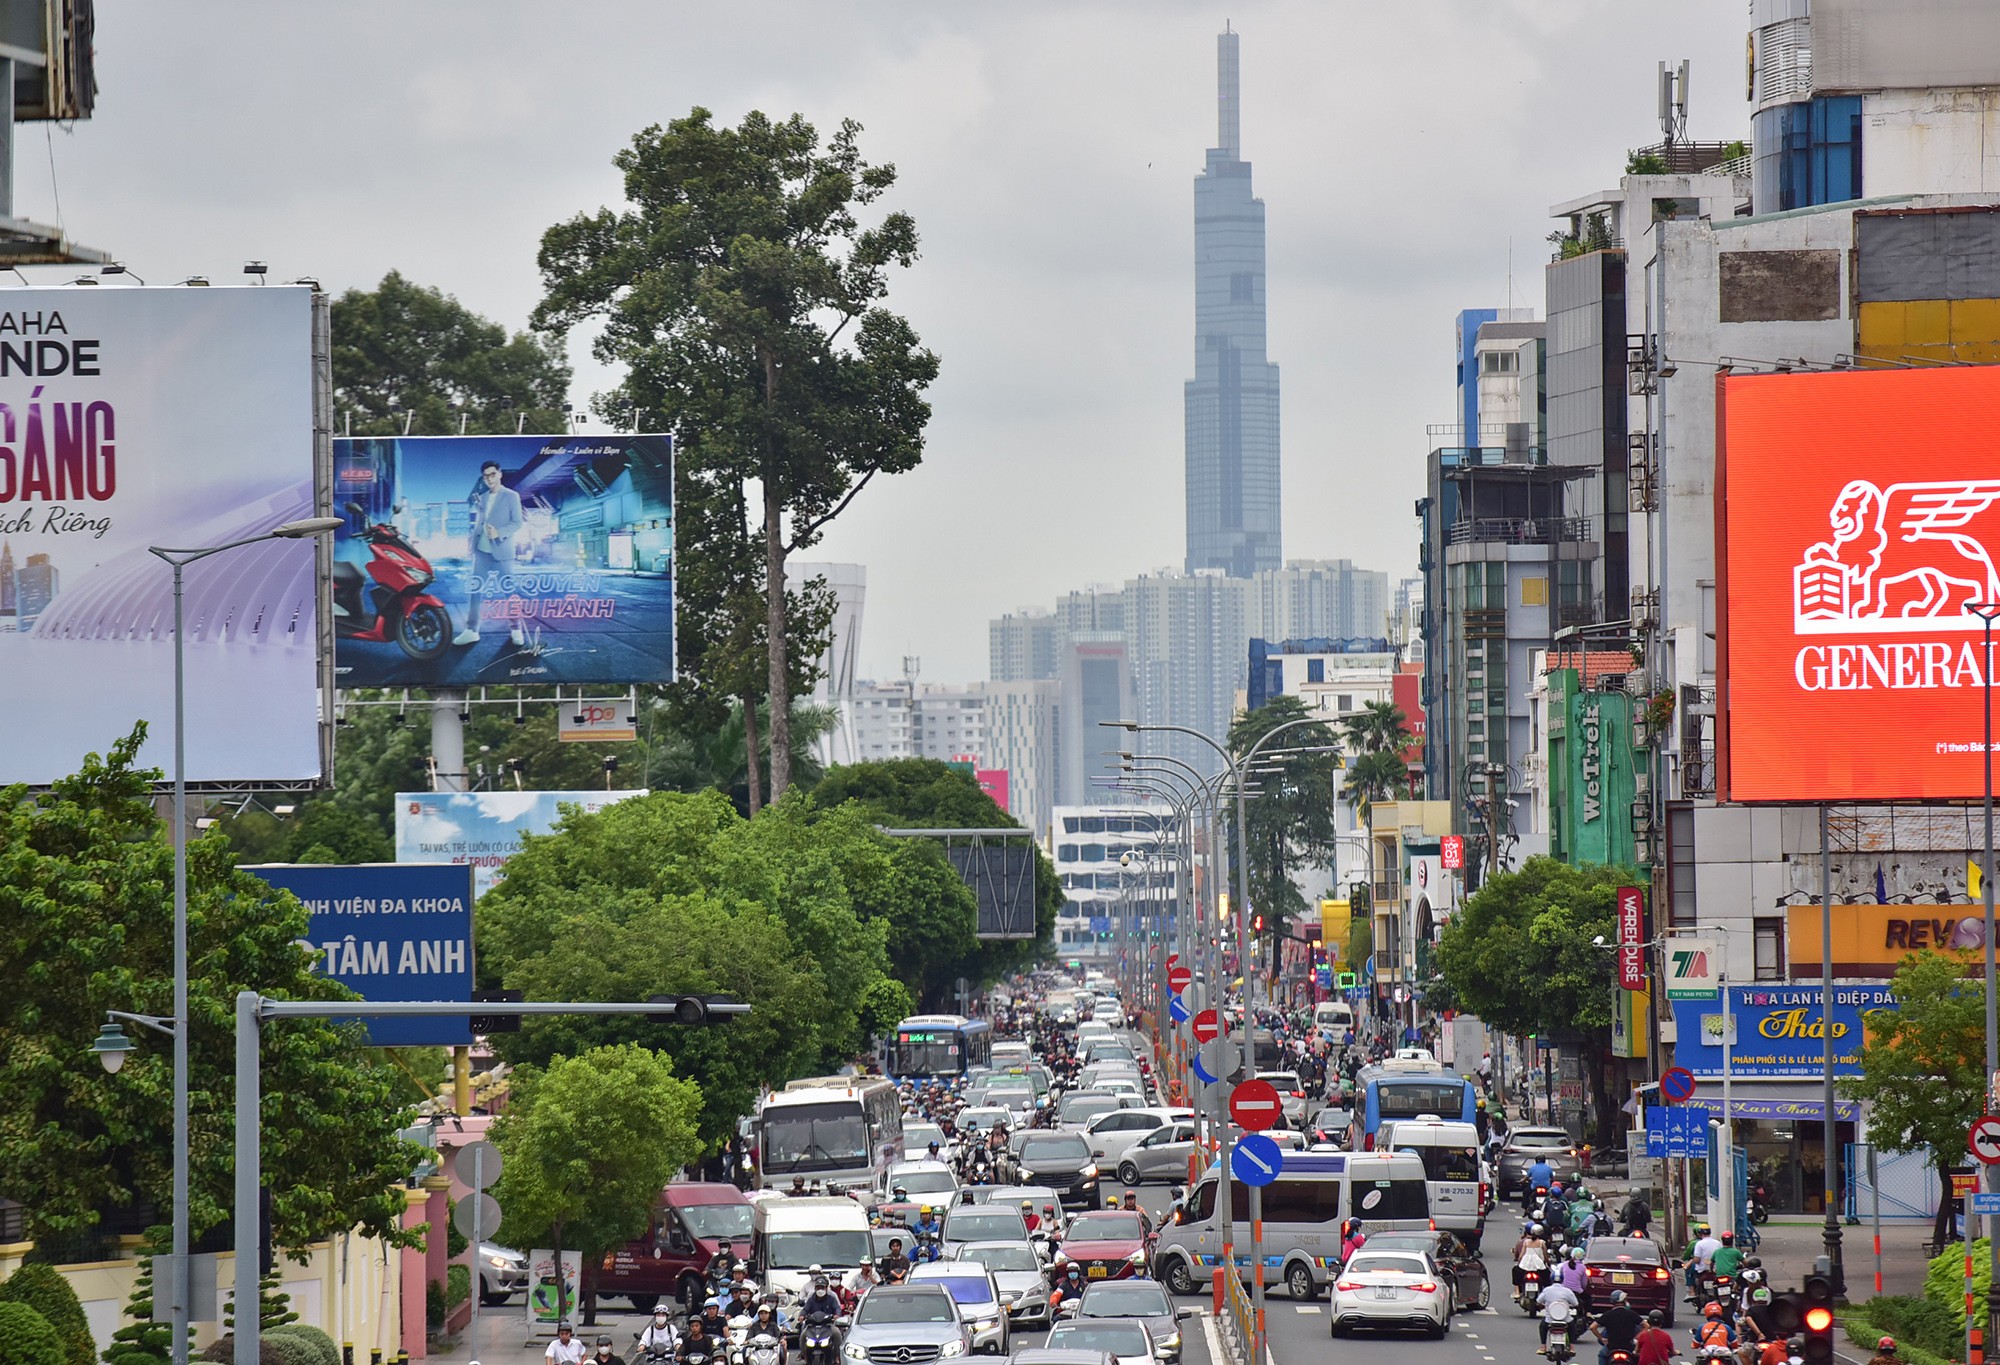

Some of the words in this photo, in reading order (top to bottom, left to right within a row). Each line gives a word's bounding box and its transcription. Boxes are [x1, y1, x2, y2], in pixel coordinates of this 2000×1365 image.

[42, 506, 112, 540] Riêng
[542, 593, 615, 618] HÃNH
[1583, 704, 1600, 823] WeTrek
[333, 896, 376, 918] VIỆN
[380, 899, 407, 913] ĐA
[412, 898, 463, 913] KHOA
[321, 934, 389, 975] TÂM
[398, 940, 465, 974] ANH
[1624, 895, 1639, 982] WAREHOUSE
[1784, 992, 1811, 1004] LAN
[1838, 990, 1870, 1007] ĐIỆP
